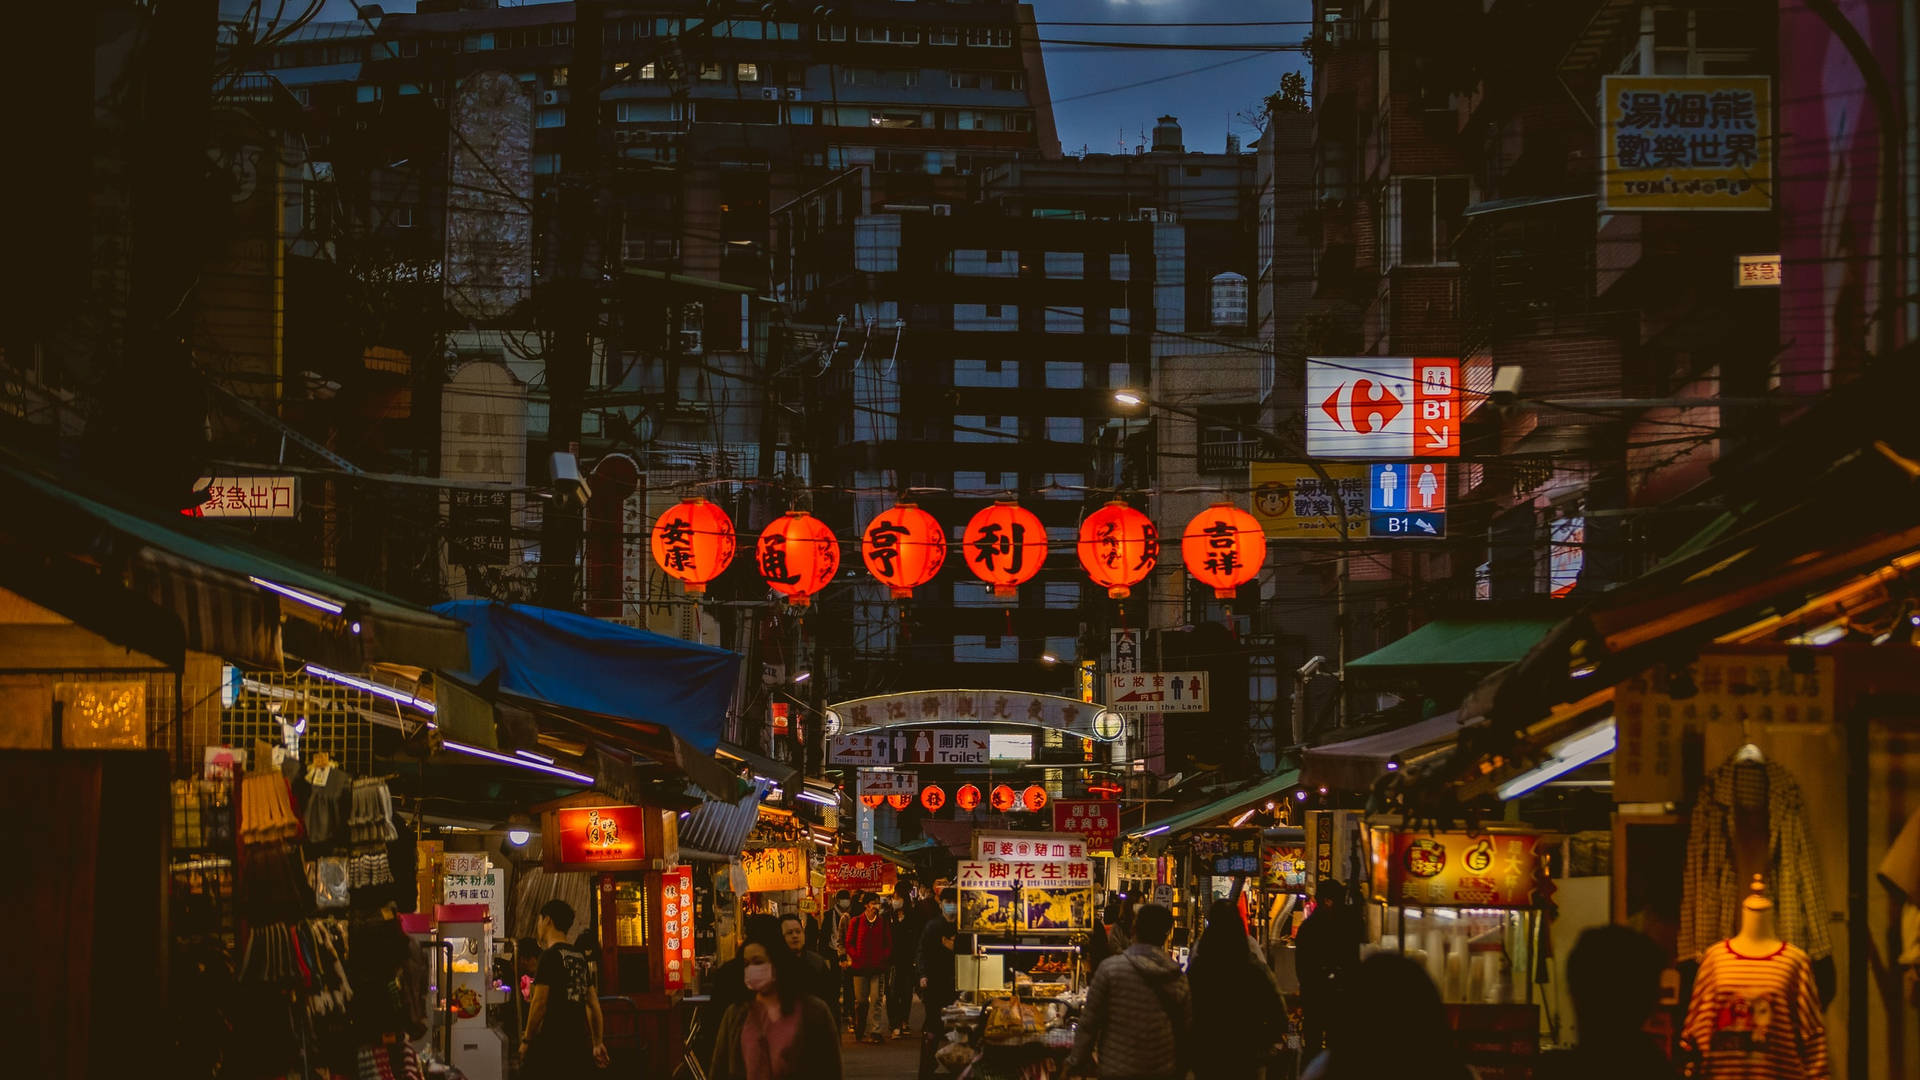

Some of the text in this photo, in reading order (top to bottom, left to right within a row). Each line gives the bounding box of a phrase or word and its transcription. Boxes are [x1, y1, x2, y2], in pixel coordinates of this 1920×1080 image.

[1617, 92, 1756, 129] 湯姆熊
[1616, 133, 1757, 168] 歡樂世界
[1744, 263, 1783, 281] 緊急
[1423, 400, 1450, 419] B1
[205, 486, 290, 509] 緊急出口
[1388, 518, 1408, 532] B1
[660, 517, 697, 572] 安康
[756, 534, 801, 585] 通
[869, 521, 911, 578] 亨
[973, 523, 1026, 574] 利
[1203, 521, 1243, 576] 吉祥
[939, 751, 983, 763] Toilet
